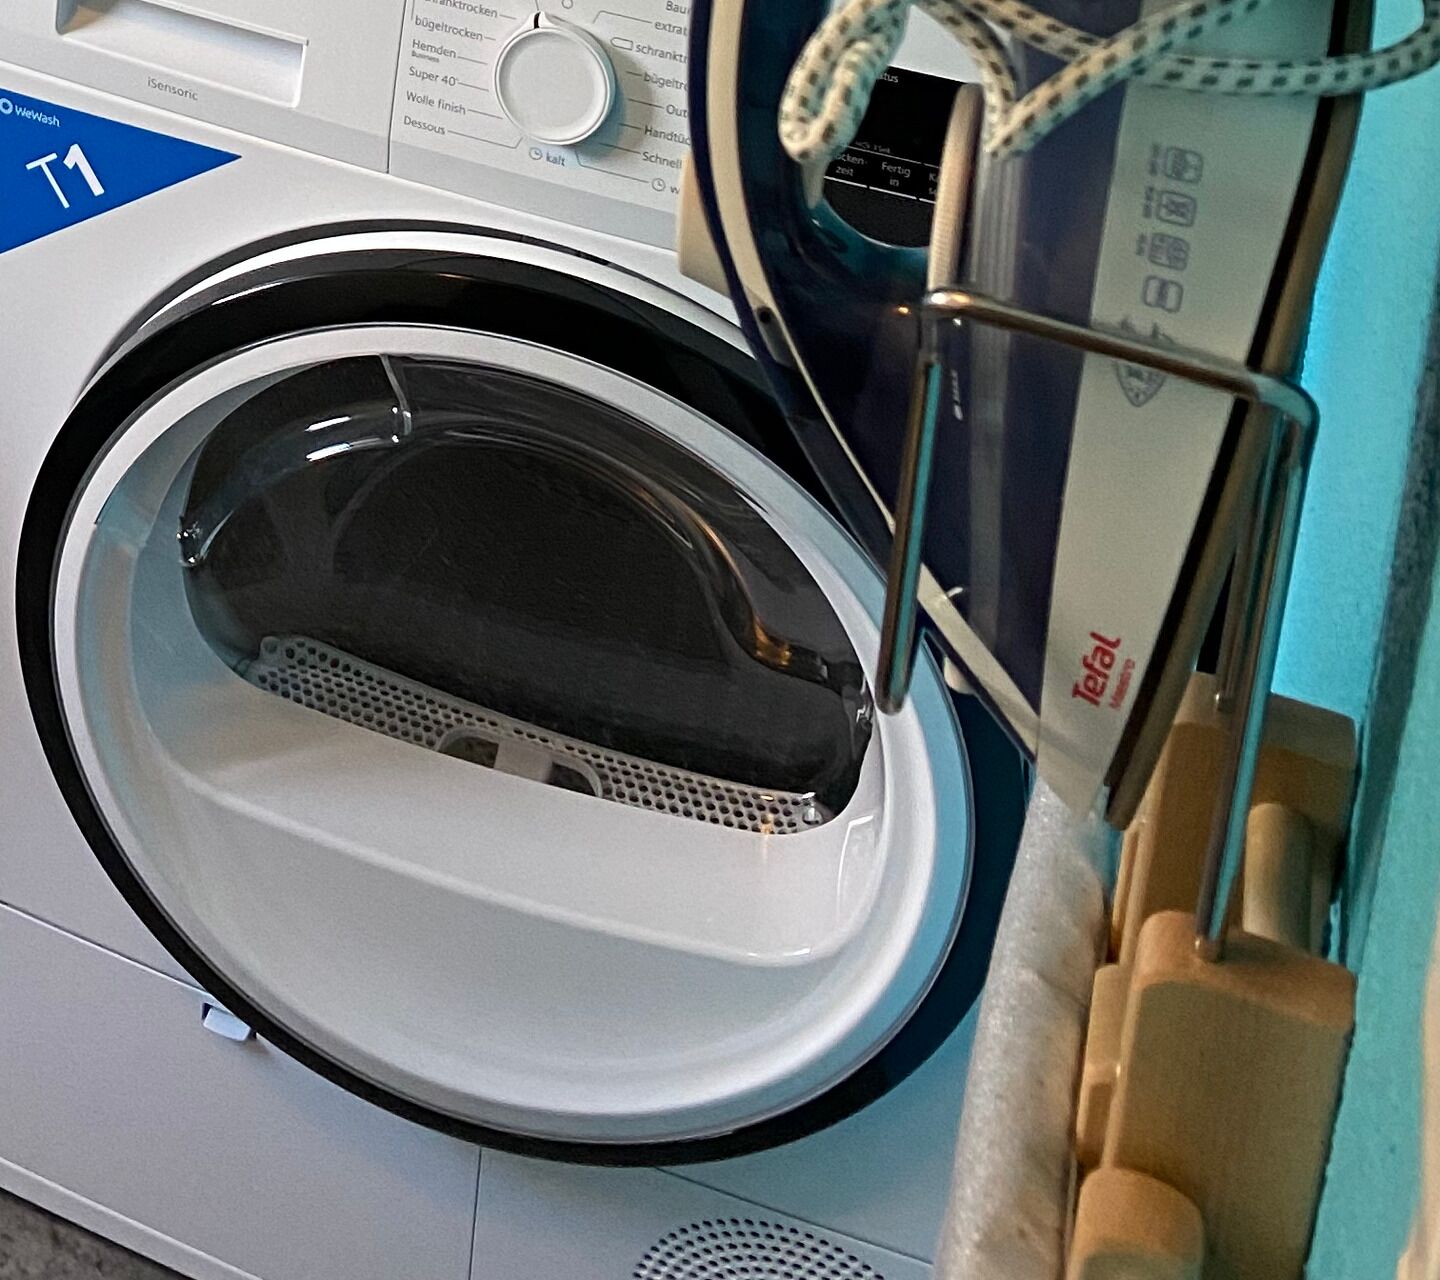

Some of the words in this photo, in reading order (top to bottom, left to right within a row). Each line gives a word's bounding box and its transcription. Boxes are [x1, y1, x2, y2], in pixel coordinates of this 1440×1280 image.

[415, 16, 484, 41] bügeltrocken
[412, 39, 458, 59] Hemden
[409, 66, 439, 83] Super
[147, 76, 199, 101] iSensoric
[406, 90, 435, 108] Wolle
[437, 99, 466, 115] finish
[14, 106, 60, 127] WeWash
[403, 115, 447, 135] Dessous
[546, 152, 566, 167] kalt
[881, 161, 911, 178] Fertig
[25, 143, 105, 209] T1
[1072, 631, 1122, 707] Tefal
